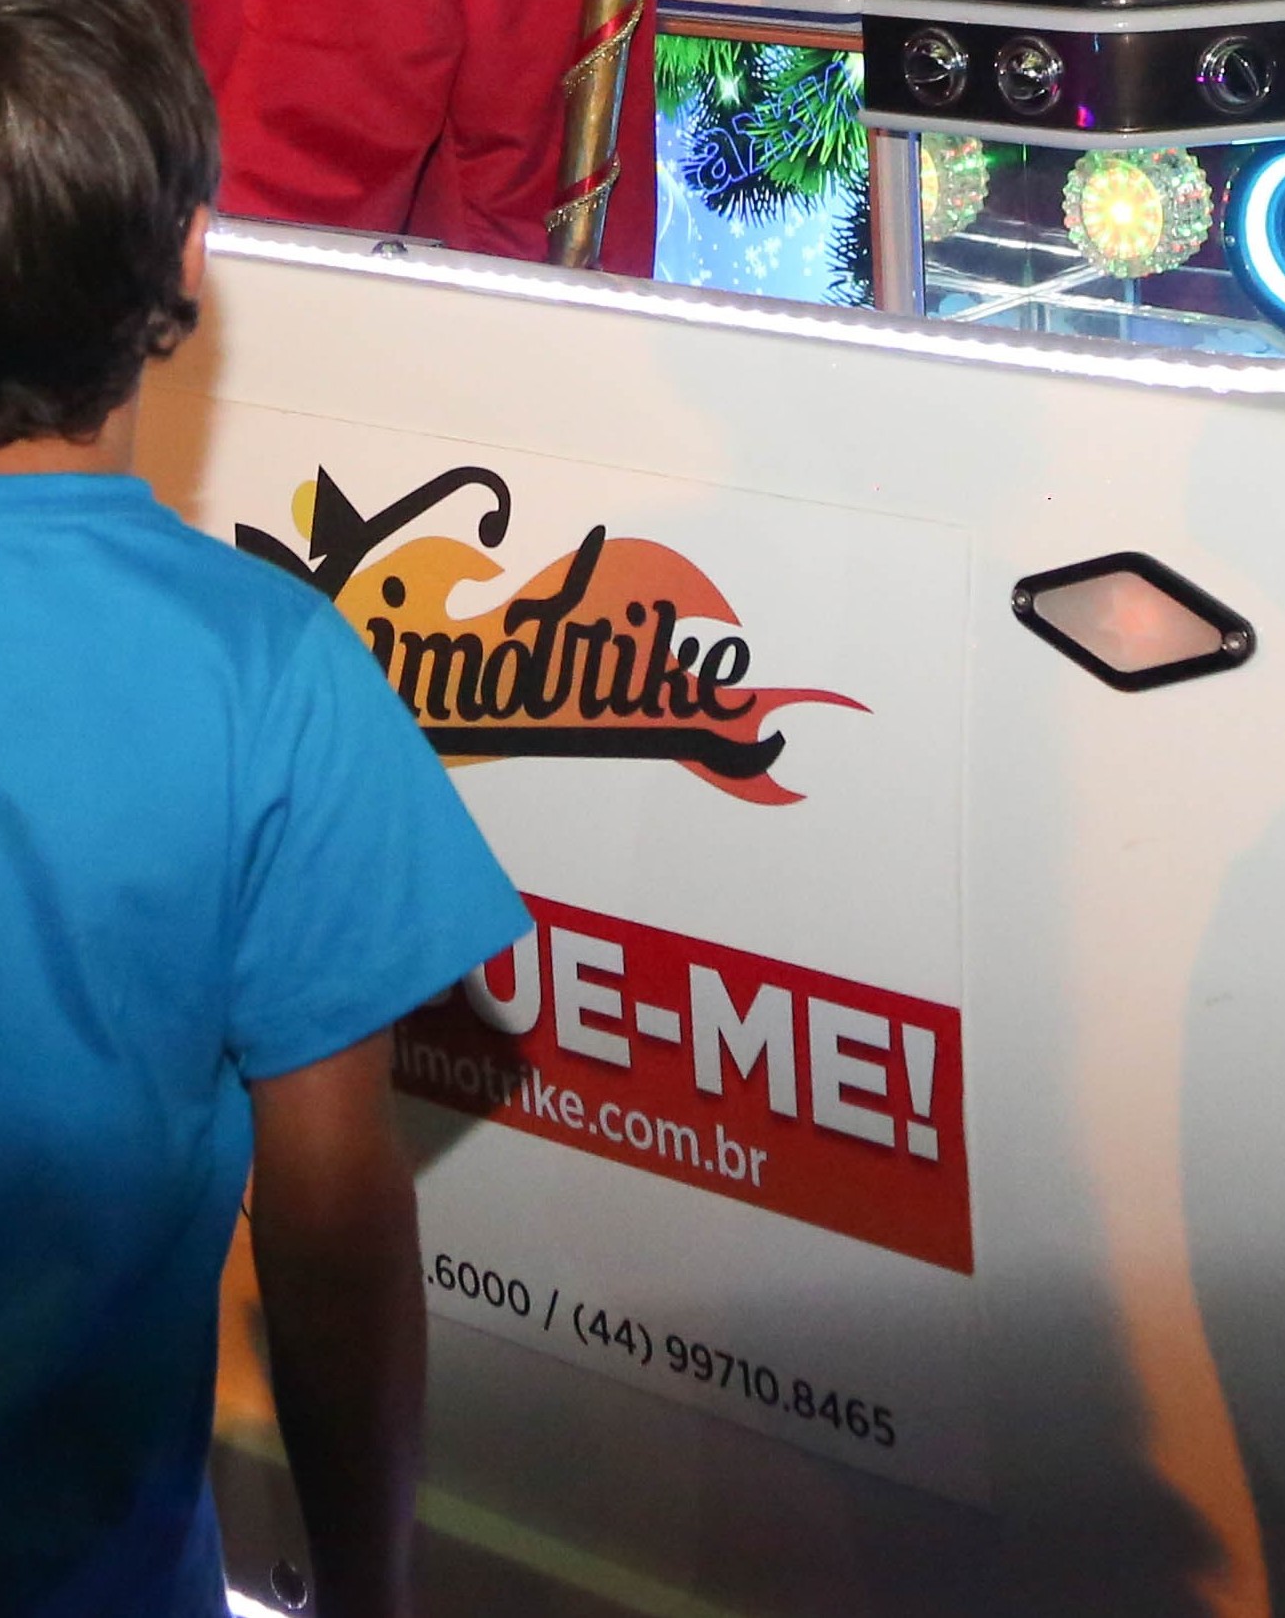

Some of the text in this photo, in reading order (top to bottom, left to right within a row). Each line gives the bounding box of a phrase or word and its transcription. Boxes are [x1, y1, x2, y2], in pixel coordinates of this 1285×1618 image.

[428, 920, 939, 1162] UE-ME!
[571, 1302, 653, 1365] (44)
[665, 1335, 897, 1448] 99710.8465
